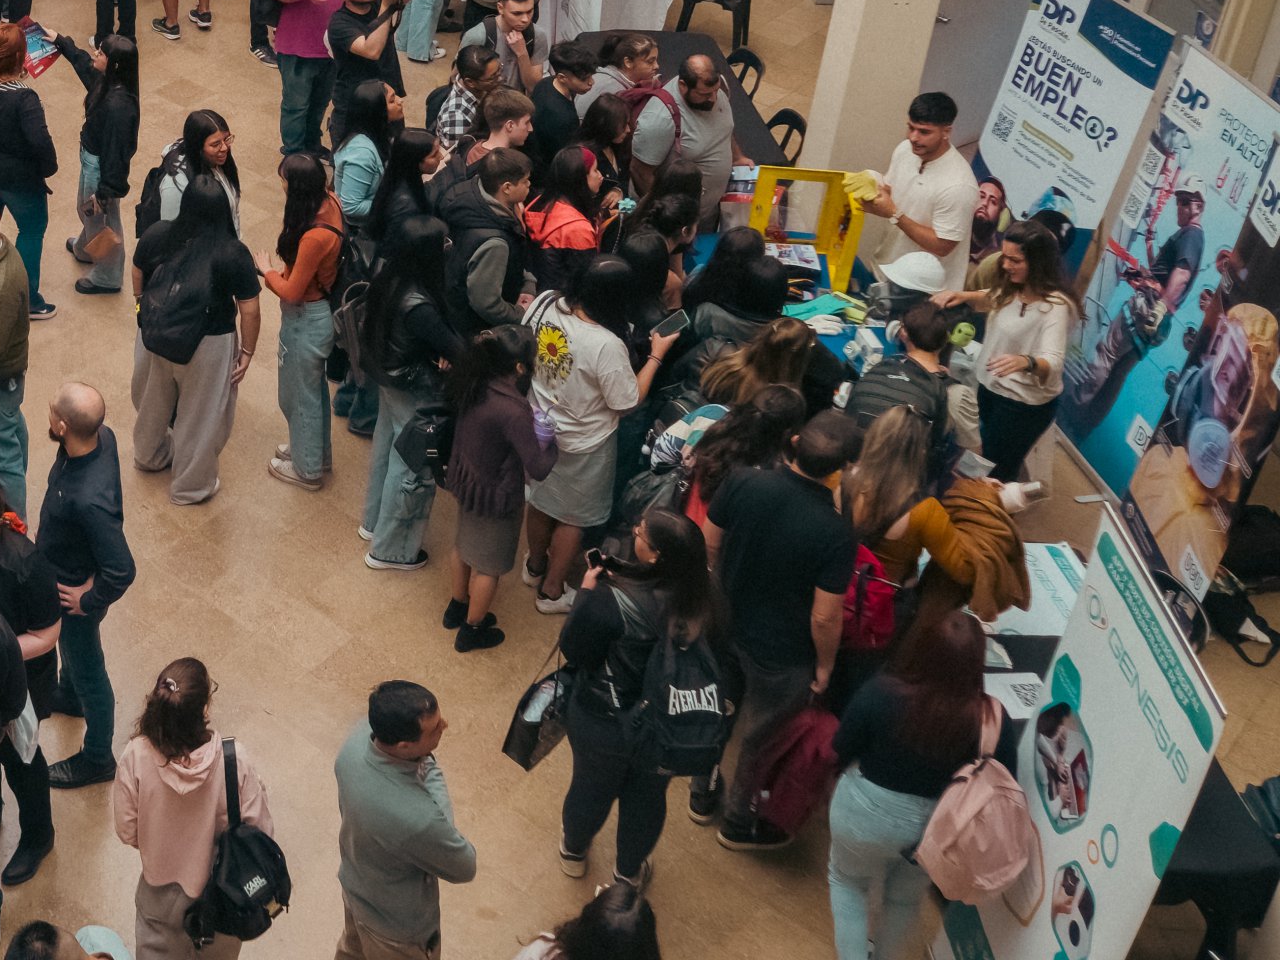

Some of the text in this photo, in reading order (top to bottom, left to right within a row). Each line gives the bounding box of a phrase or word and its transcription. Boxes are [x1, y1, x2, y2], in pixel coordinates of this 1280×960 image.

[1020, 43, 1083, 98] BUEN
[1052, 50, 1092, 79] BUSCANDO
[1092, 75, 1104, 87] UN
[1176, 78, 1211, 111] DP
[1220, 129, 1236, 147] EN
[668, 683, 723, 716] EVERLAST
[1108, 627, 1190, 785] GENESIS
[244, 875, 265, 896] KARL
